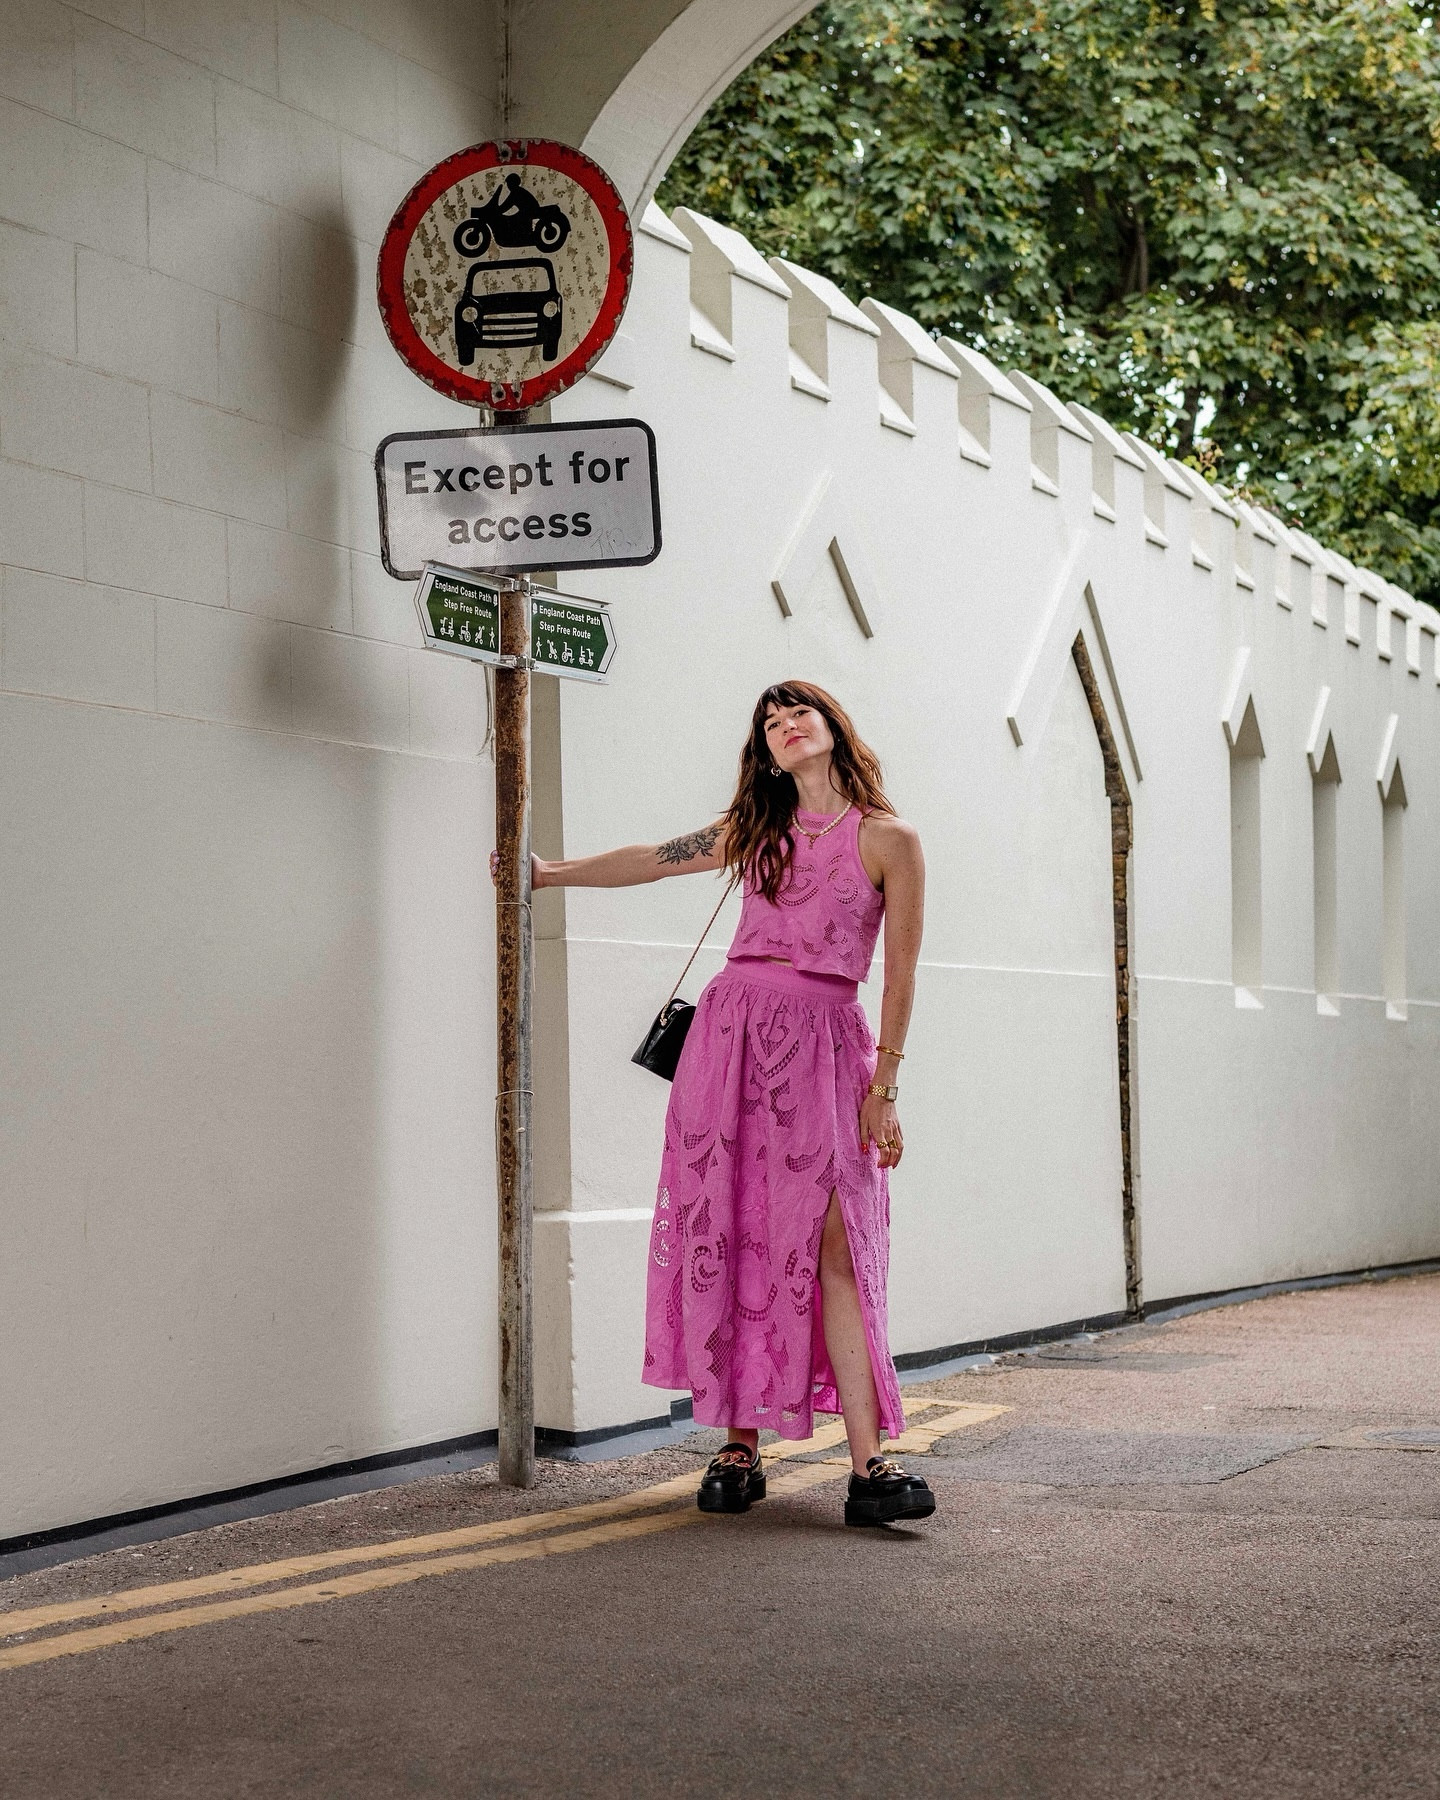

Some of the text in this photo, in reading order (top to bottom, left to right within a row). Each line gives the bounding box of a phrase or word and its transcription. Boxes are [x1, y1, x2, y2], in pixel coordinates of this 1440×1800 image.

[404, 450, 630, 495] Except for
[448, 511, 592, 545] access
[434, 579, 492, 603] England Coast Path
[444, 598, 492, 619] Step Free Route
[539, 605, 601, 626] England Coast Path
[539, 621, 591, 640] Step Free Route
